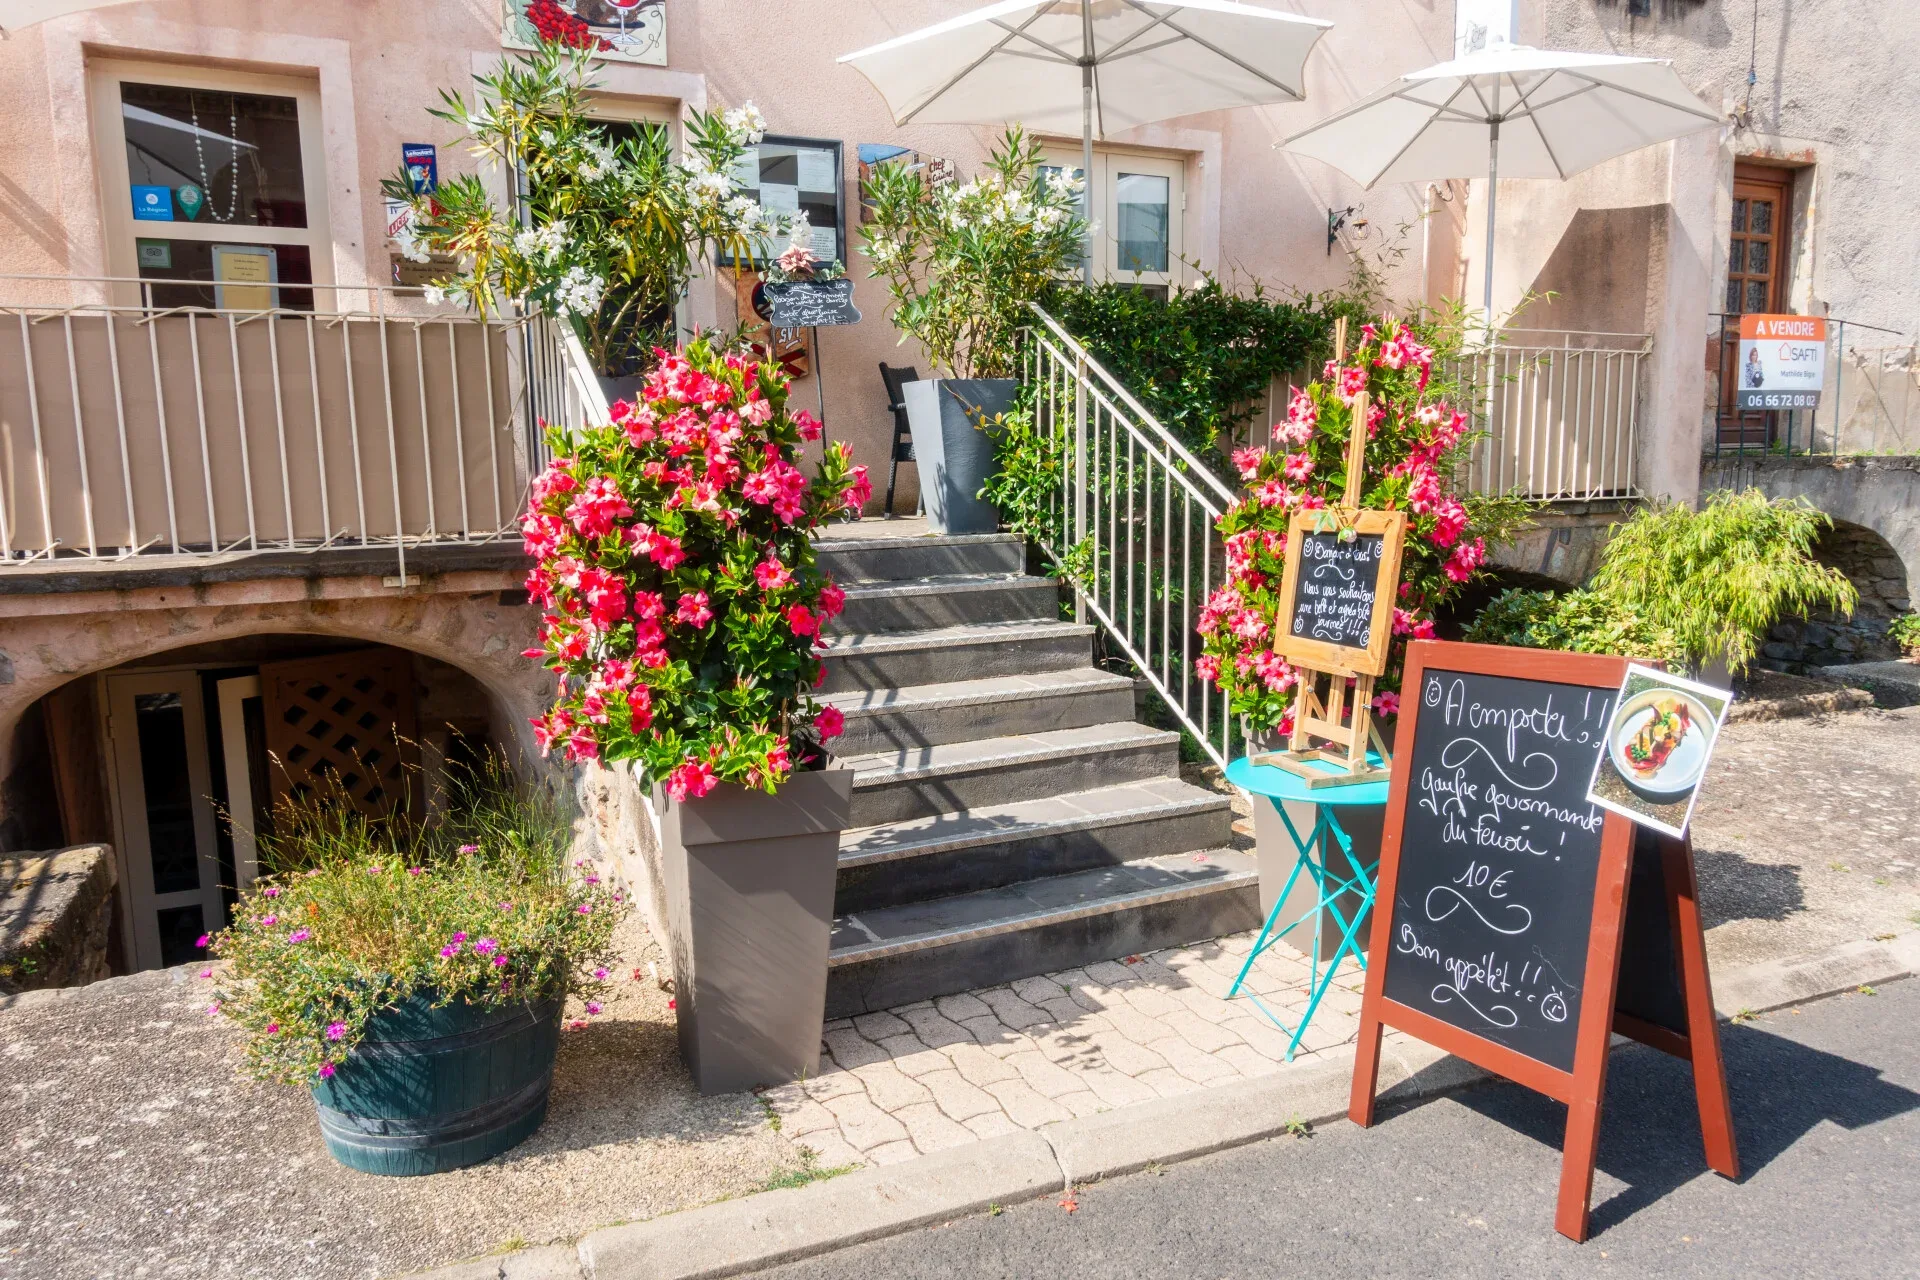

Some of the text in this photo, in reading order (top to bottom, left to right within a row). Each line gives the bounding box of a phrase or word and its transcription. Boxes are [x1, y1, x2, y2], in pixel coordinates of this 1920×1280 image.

[929, 158, 945, 173] Chef
[1756, 321, 1815, 336] A VENDRE
[1748, 395, 1815, 406] 06 66 72 08 02
[1304, 581, 1374, 603] Nous vous souhaitons
[1298, 598, 1370, 621] une belle et agréable
[1446, 679, 1464, 726] A
[1470, 694, 1571, 763] emporter
[1479, 784, 1602, 833] gourmande
[1443, 812, 1467, 844] du
[1396, 923, 1440, 964] Bon
